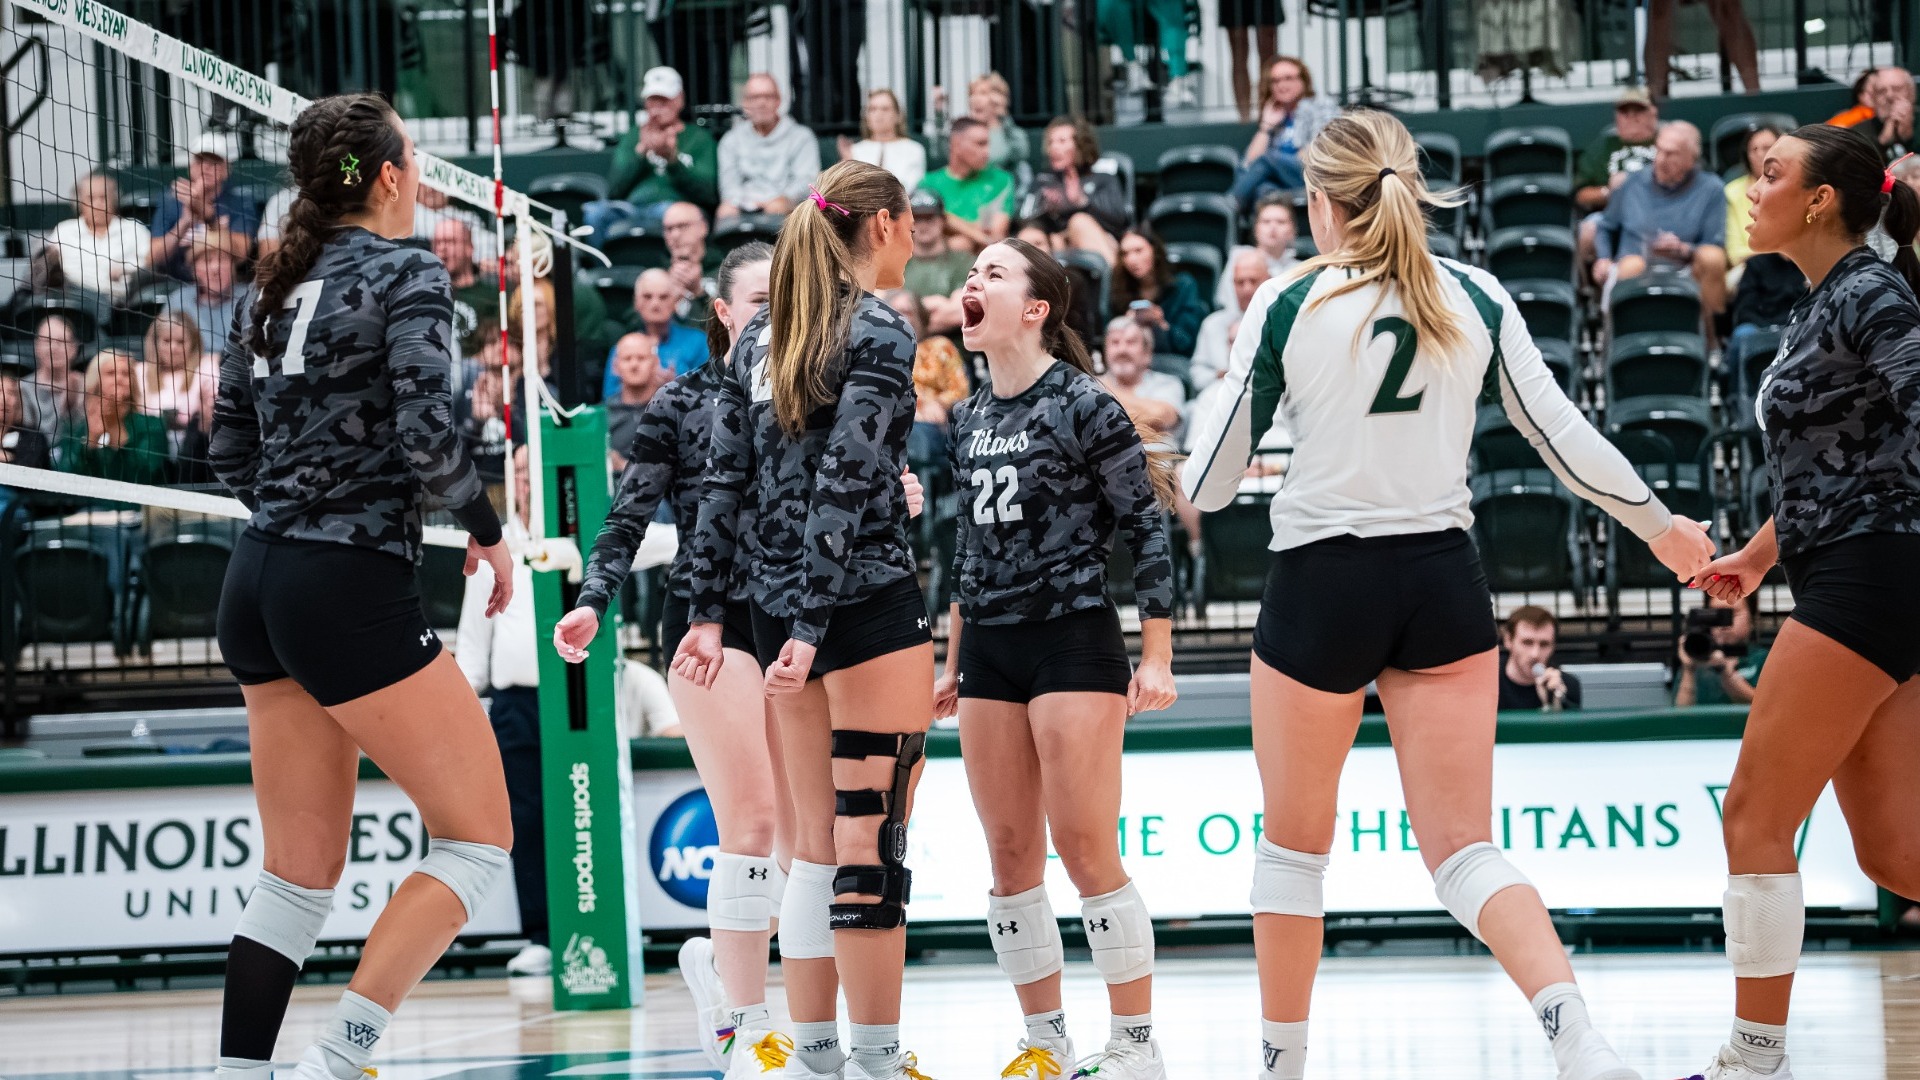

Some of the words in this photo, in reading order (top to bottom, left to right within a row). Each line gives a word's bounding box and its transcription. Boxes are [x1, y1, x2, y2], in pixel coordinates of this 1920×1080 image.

[1365, 314, 1428, 418] 2
[968, 429, 1029, 458] Titans
[971, 465, 1024, 525] 22
[570, 762, 593, 830] sports
[0, 817, 251, 876] LLINOIS
[1350, 809, 1419, 852] HE
[1502, 803, 1681, 849] ITANS
[573, 831, 597, 914] imports
[659, 845, 720, 882] NC
[829, 914, 861, 922] ONJOY
